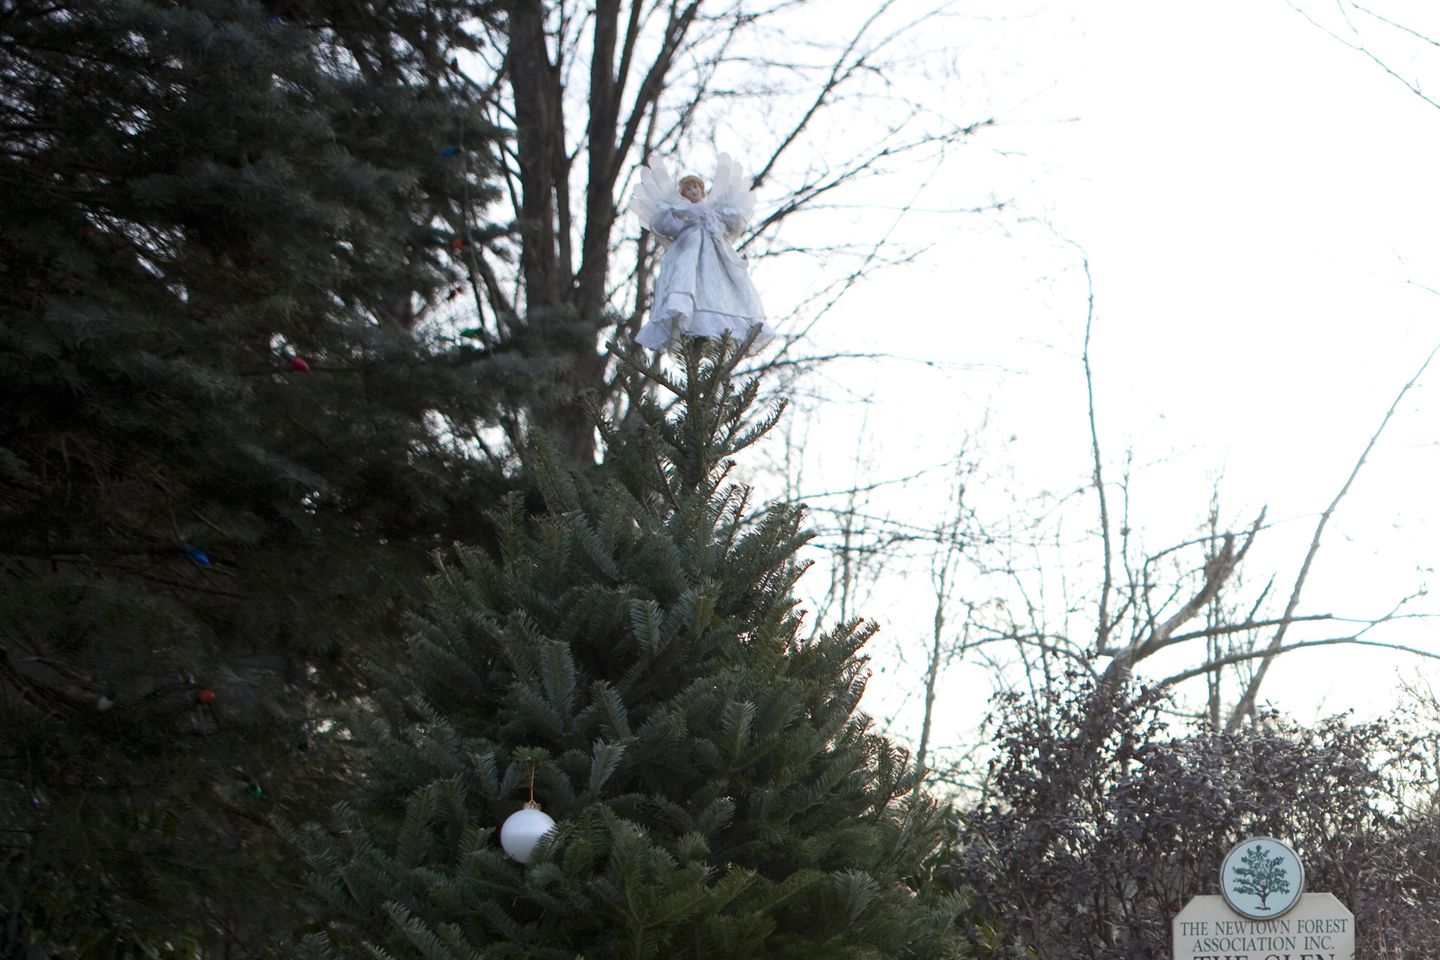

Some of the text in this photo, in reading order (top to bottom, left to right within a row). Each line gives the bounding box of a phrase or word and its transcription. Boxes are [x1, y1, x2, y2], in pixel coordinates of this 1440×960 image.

[1181, 918, 1348, 936] THE NEWTOWN FOREST
[1193, 936, 1335, 952] ASSOCIATION INC.
